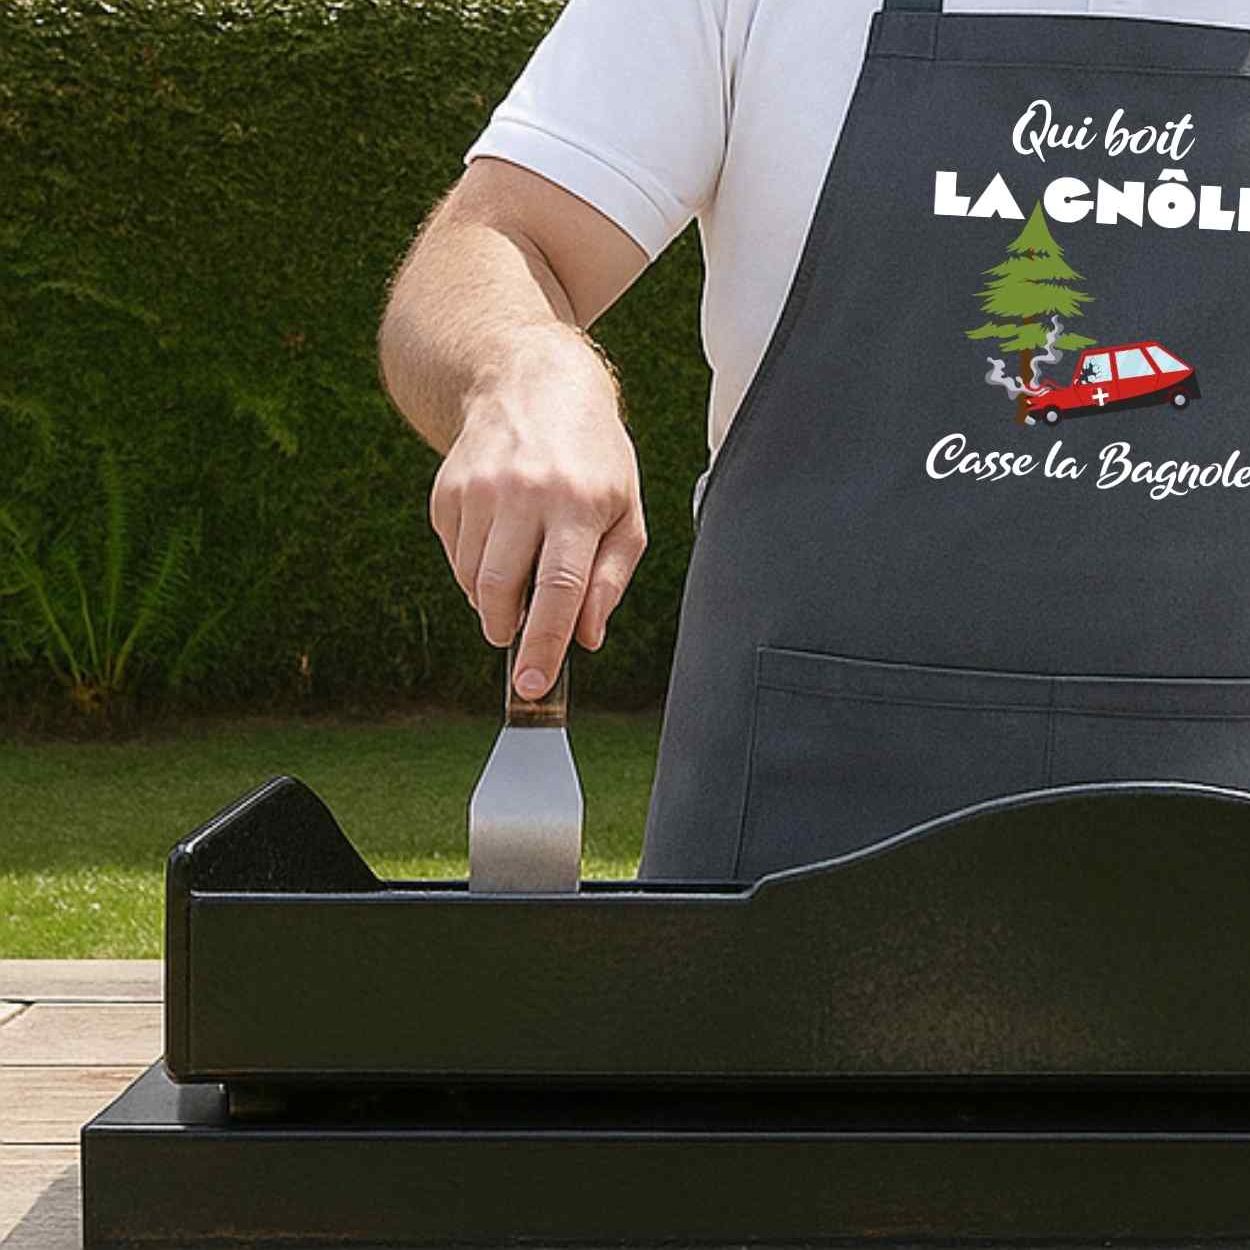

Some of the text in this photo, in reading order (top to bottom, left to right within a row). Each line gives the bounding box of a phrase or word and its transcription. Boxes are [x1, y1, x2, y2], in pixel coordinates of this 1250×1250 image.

[1012, 99, 1196, 163] Qui boit
[933, 170, 1026, 220] LA
[925, 433, 1040, 482] Casse
[1044, 440, 1088, 480] la
